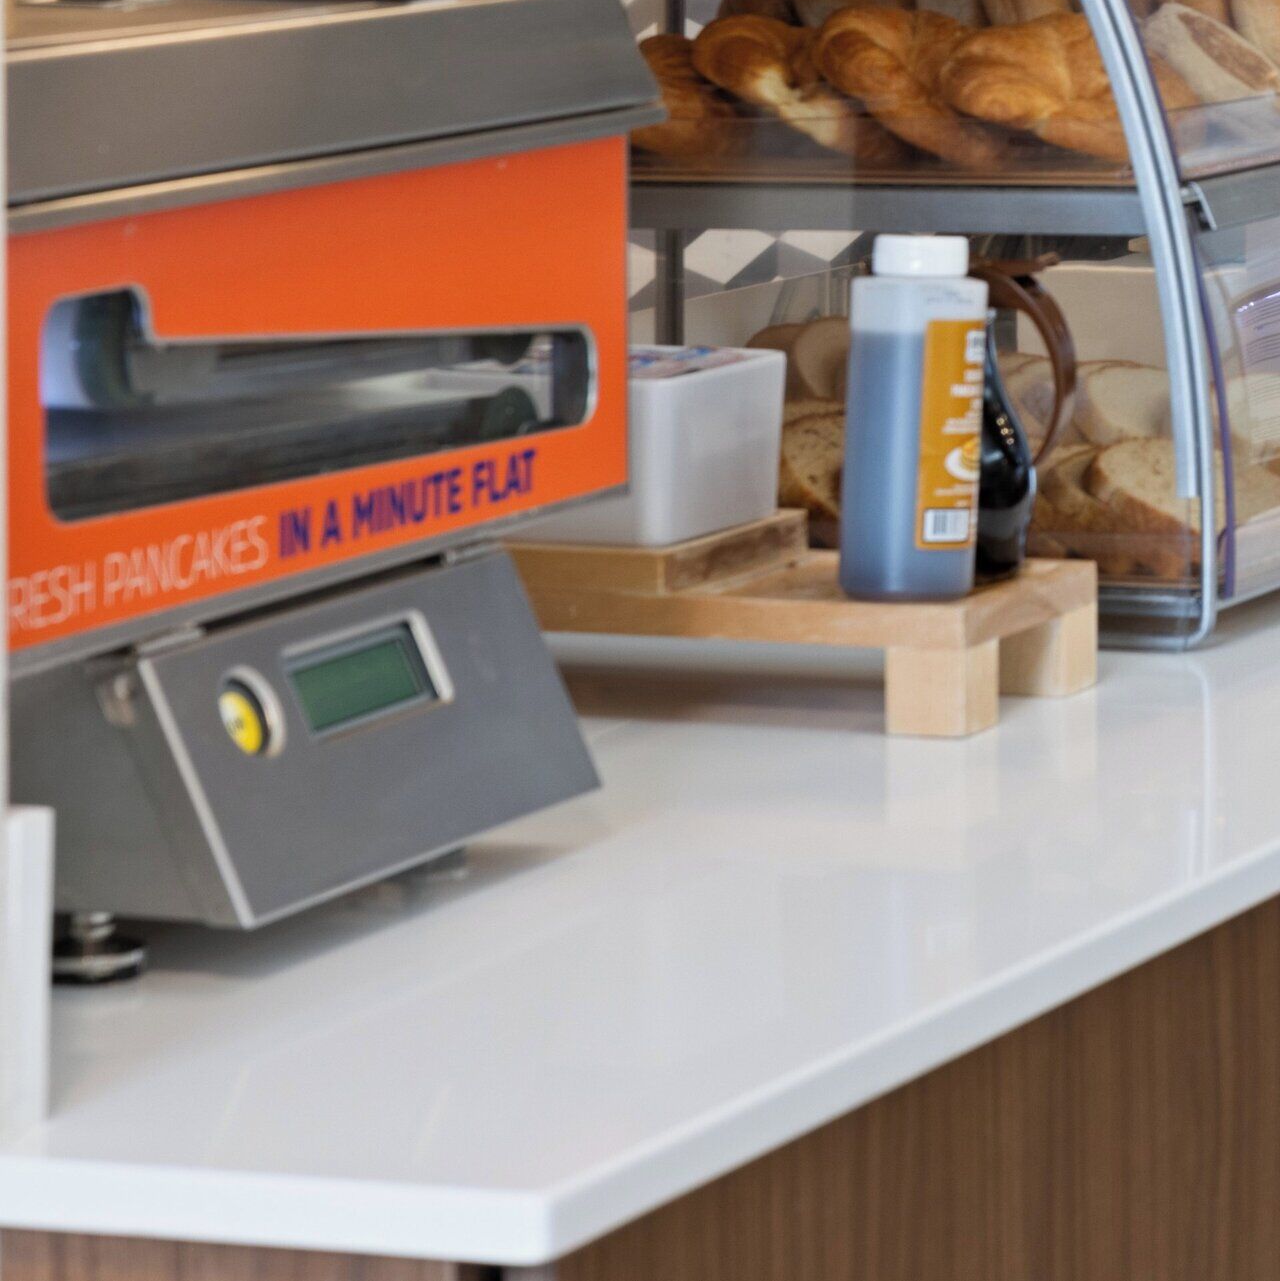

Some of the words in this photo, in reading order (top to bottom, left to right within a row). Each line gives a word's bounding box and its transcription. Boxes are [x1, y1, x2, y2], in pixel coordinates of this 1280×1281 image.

[103, 513, 269, 608] PANCAKES
[279, 506, 312, 559] IN
[320, 498, 342, 548] A
[353, 466, 463, 539] MINUTE
[471, 448, 536, 507] FLAT
